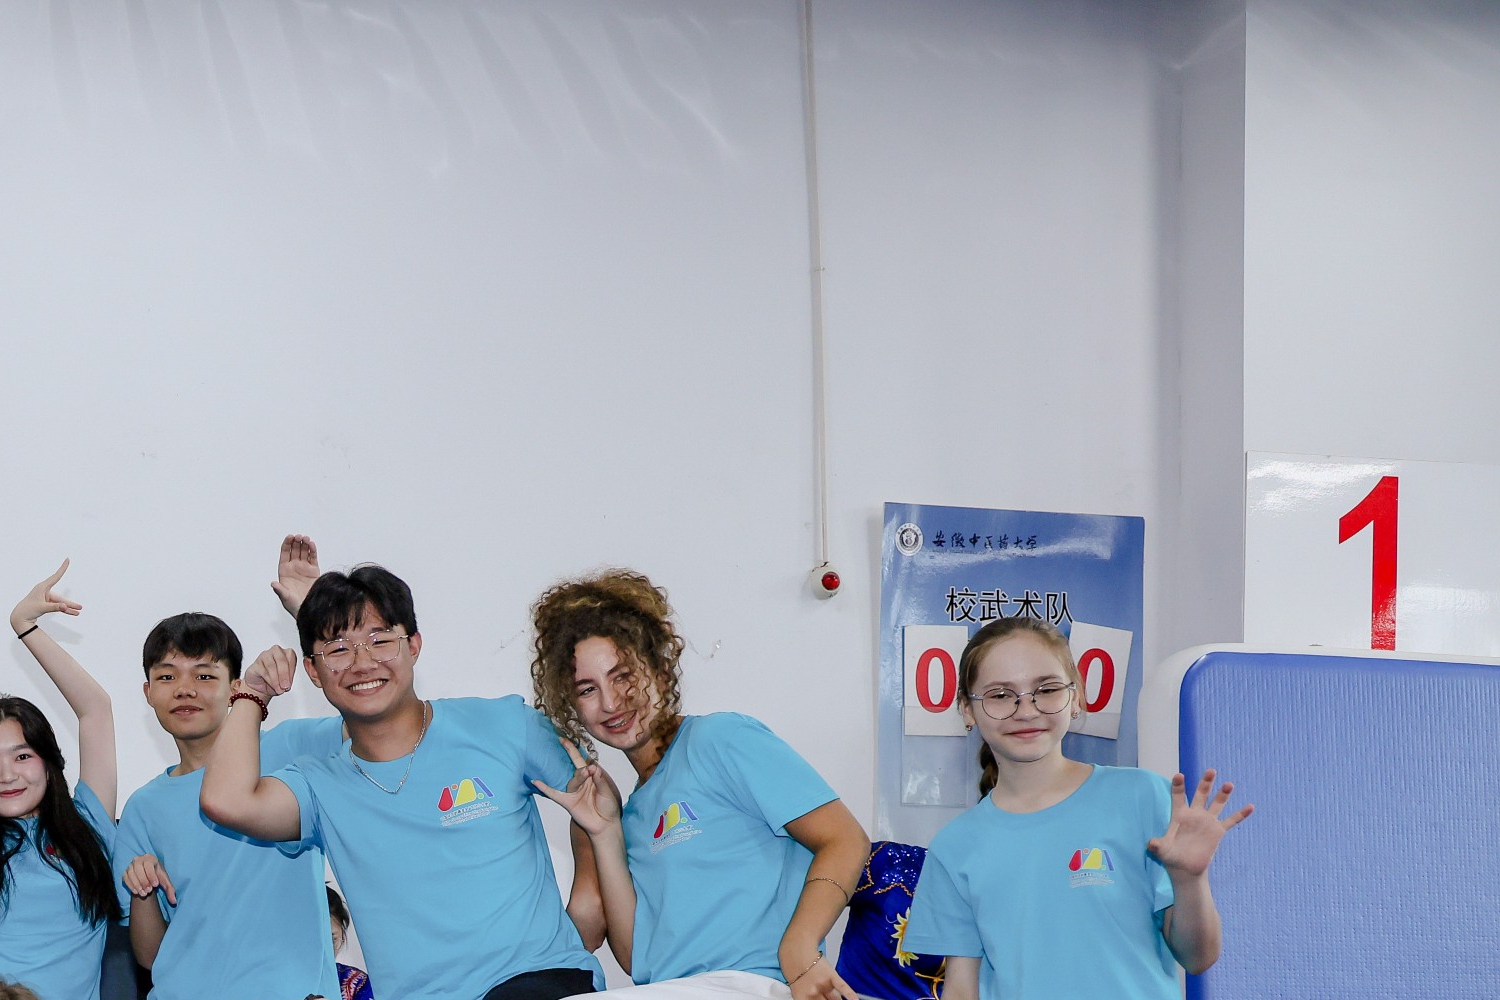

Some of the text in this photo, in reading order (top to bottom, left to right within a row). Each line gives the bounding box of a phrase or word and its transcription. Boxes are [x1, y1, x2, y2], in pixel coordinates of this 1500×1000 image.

[1338, 476, 1399, 651] 1
[946, 587, 1073, 624] 校武术队
[915, 648, 957, 713] 0
[1077, 648, 1115, 713] 0
